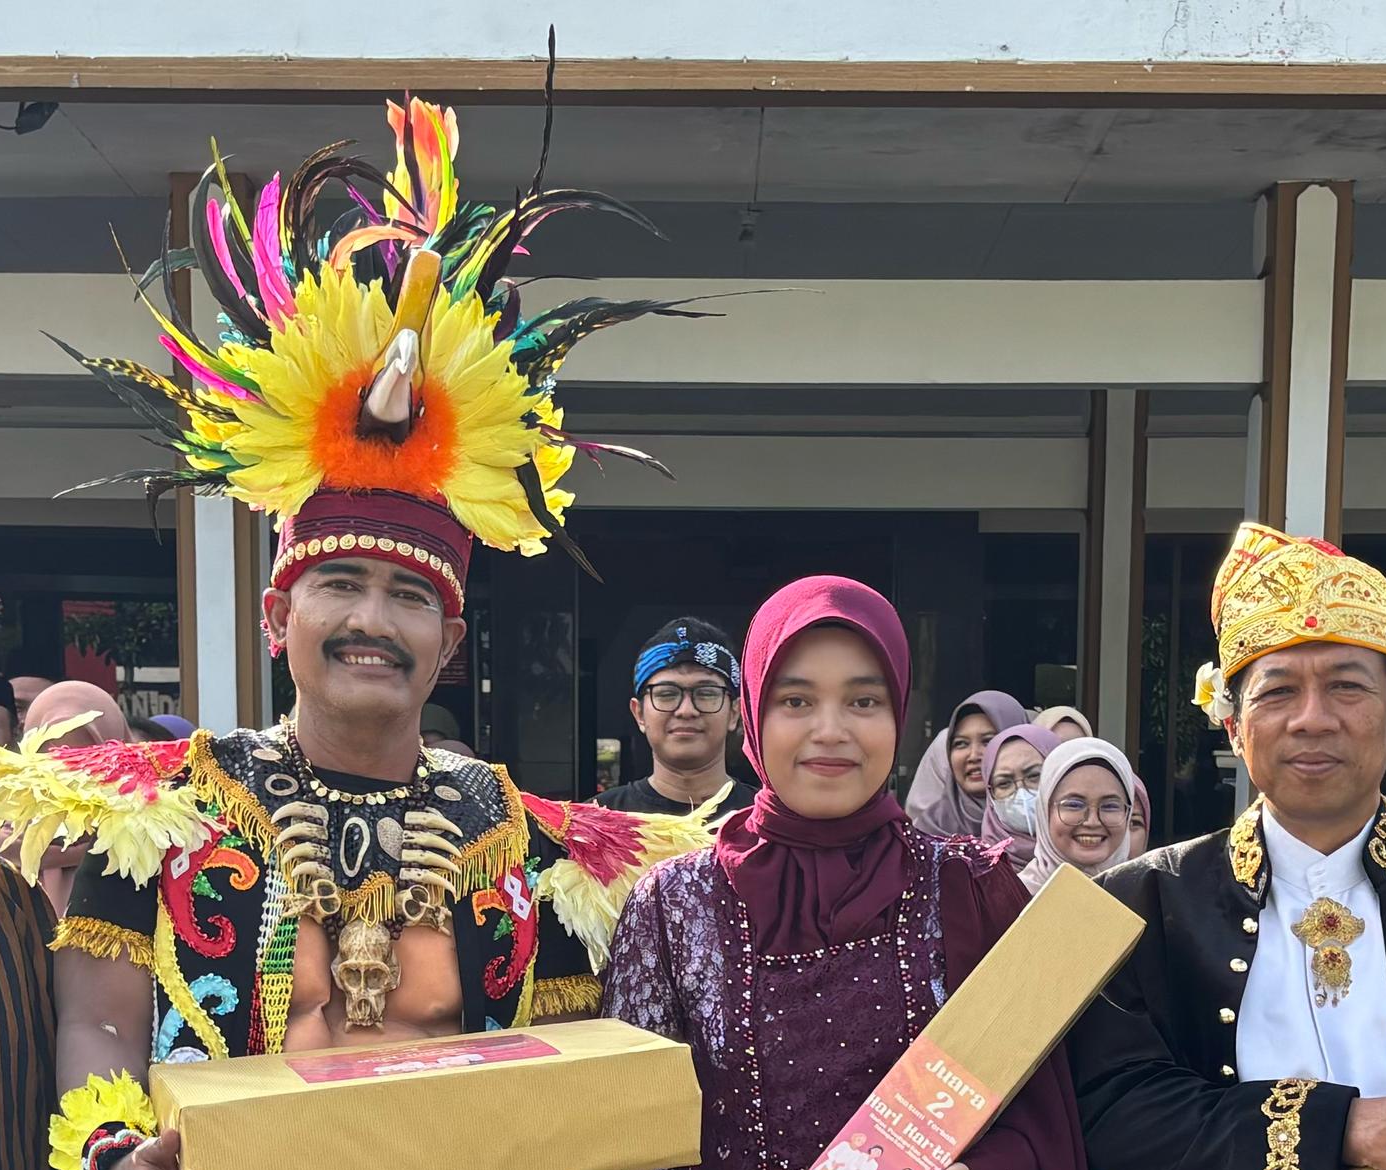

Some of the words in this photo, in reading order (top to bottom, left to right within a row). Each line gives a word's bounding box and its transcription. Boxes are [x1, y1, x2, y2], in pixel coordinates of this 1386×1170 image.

[925, 1060, 986, 1111] Juara
[865, 1094, 903, 1126] Hari
[926, 1091, 954, 1119] 2
